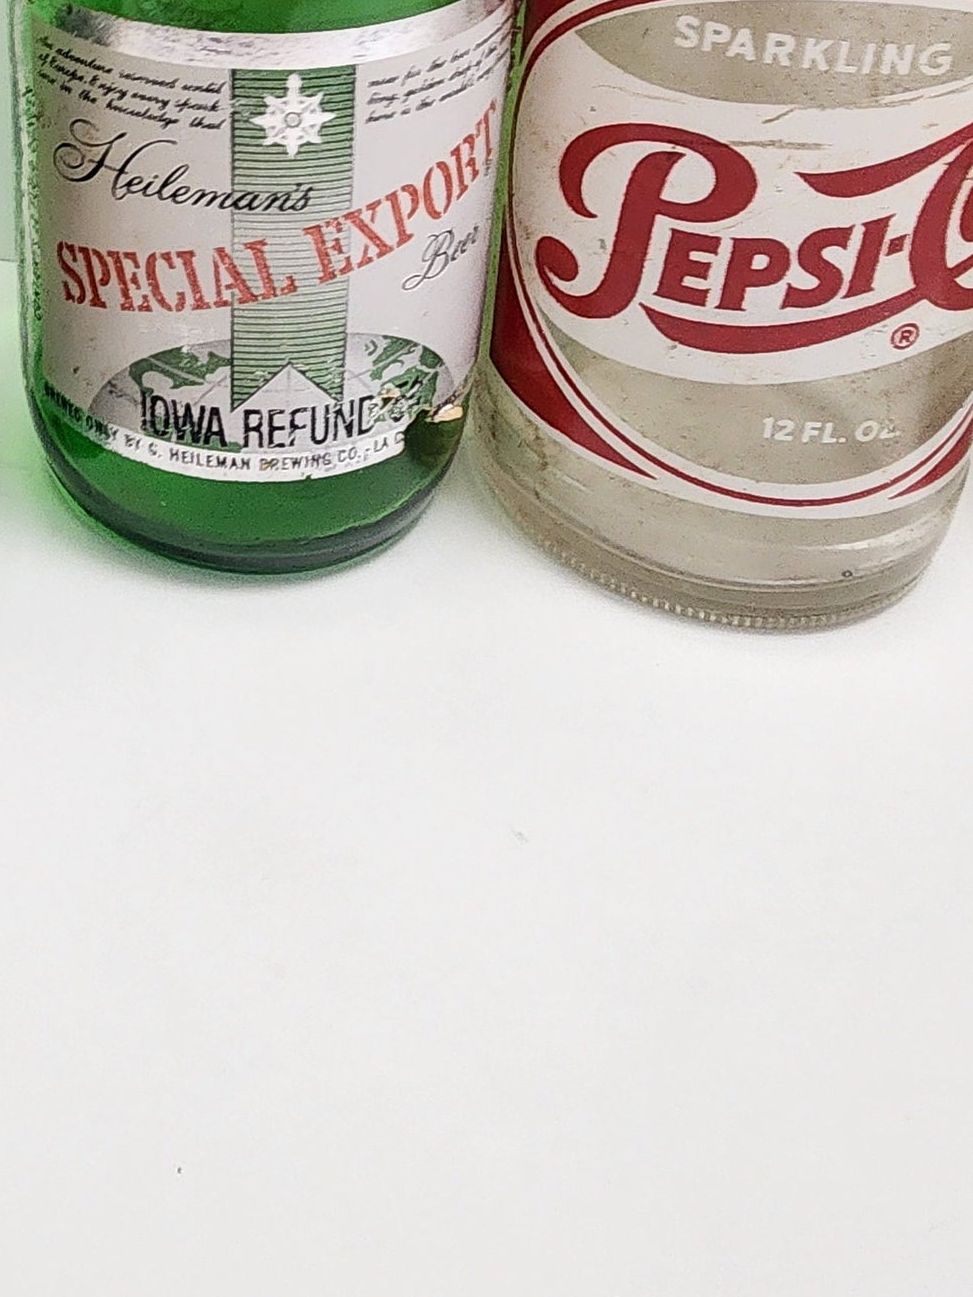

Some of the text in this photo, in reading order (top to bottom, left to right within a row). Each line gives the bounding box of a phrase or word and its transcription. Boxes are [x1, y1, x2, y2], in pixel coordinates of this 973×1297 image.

[673, 14, 954, 77] SPARKLING
[53, 118, 313, 212] Heileman's
[57, 97, 497, 312] SPECIAL EXPORT
[401, 225, 479, 290] Beer
[140, 390, 227, 447] IOWA
[762, 416, 796, 442] 12
[801, 421, 847, 444] FL.
[169, 447, 251, 471] HEILEMAN
[259, 452, 332, 471] BREWING
